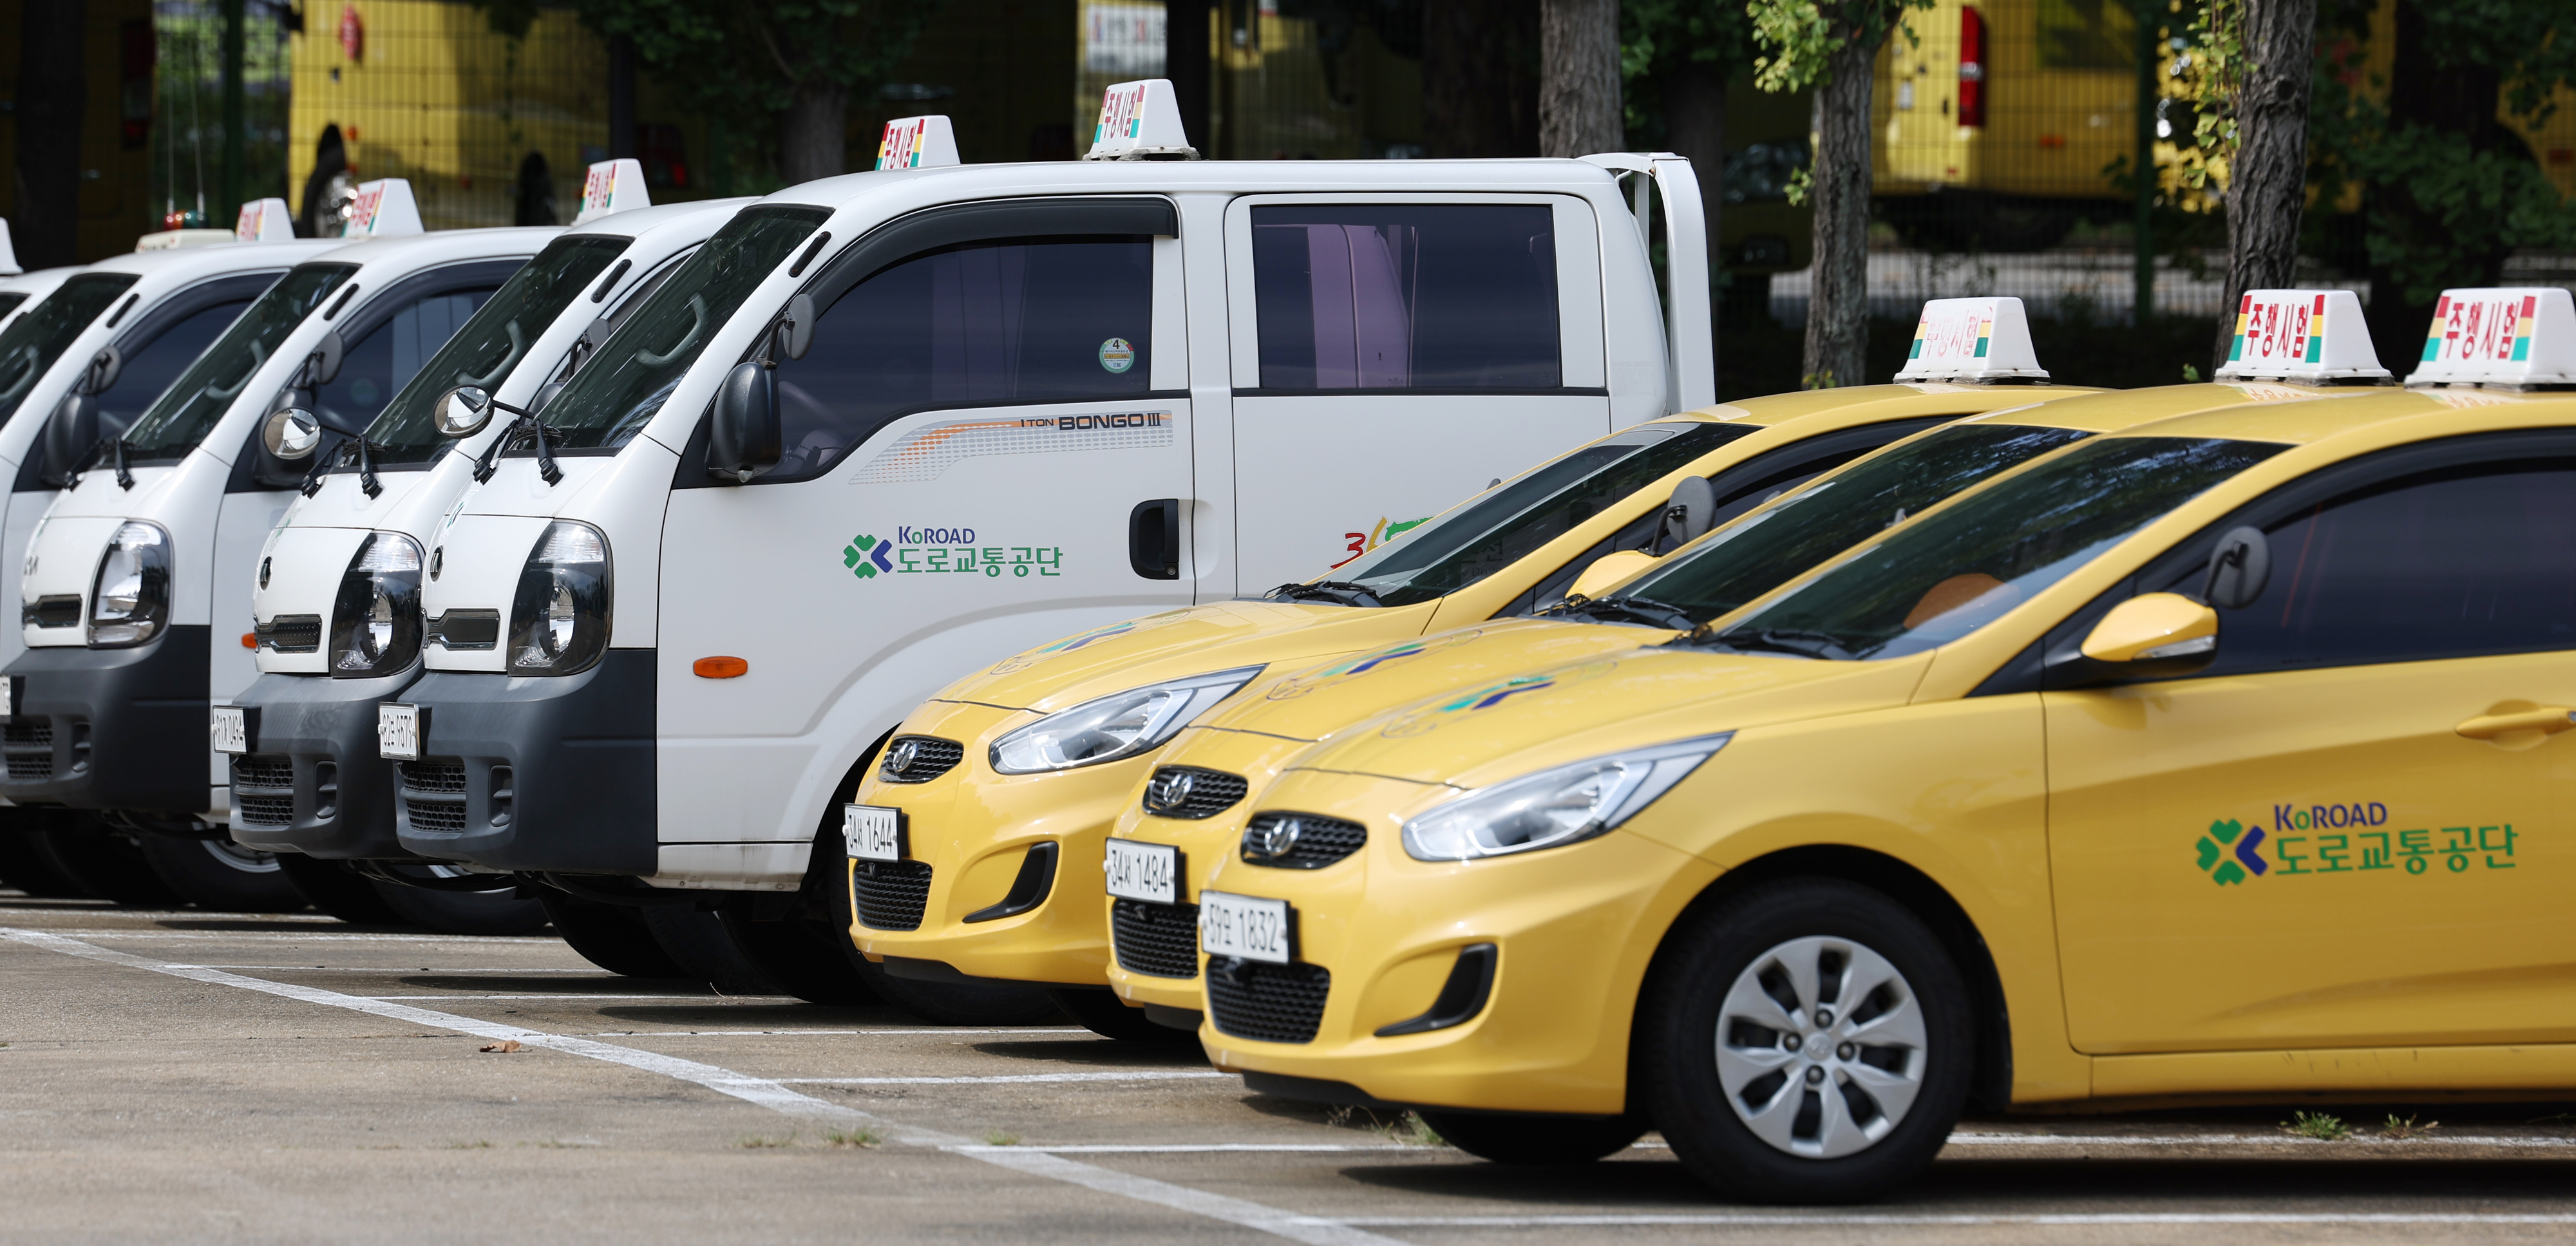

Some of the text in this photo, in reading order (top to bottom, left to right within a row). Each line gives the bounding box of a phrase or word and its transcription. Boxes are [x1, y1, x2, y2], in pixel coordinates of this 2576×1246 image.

[1103, 90, 1138, 139] 주행시험
[884, 124, 917, 170] 주행시험
[1112, 339, 1120, 349] 4
[2248, 303, 2309, 358] 주행시험
[2446, 301, 2520, 360] 주행시험
[1027, 419, 1054, 427] TON
[1058, 413, 1144, 430] BONGO
[898, 526, 976, 544] KoROAD
[897, 547, 1063, 578] 도로교통공단
[397, 714, 413, 748] 9579
[849, 814, 893, 853] 34서 1644
[2274, 801, 2389, 832] KoROAD
[2275, 824, 2519, 875] 도로교통공단
[1112, 849, 1168, 894] 34서 1484
[1239, 908, 1278, 952] 1832
